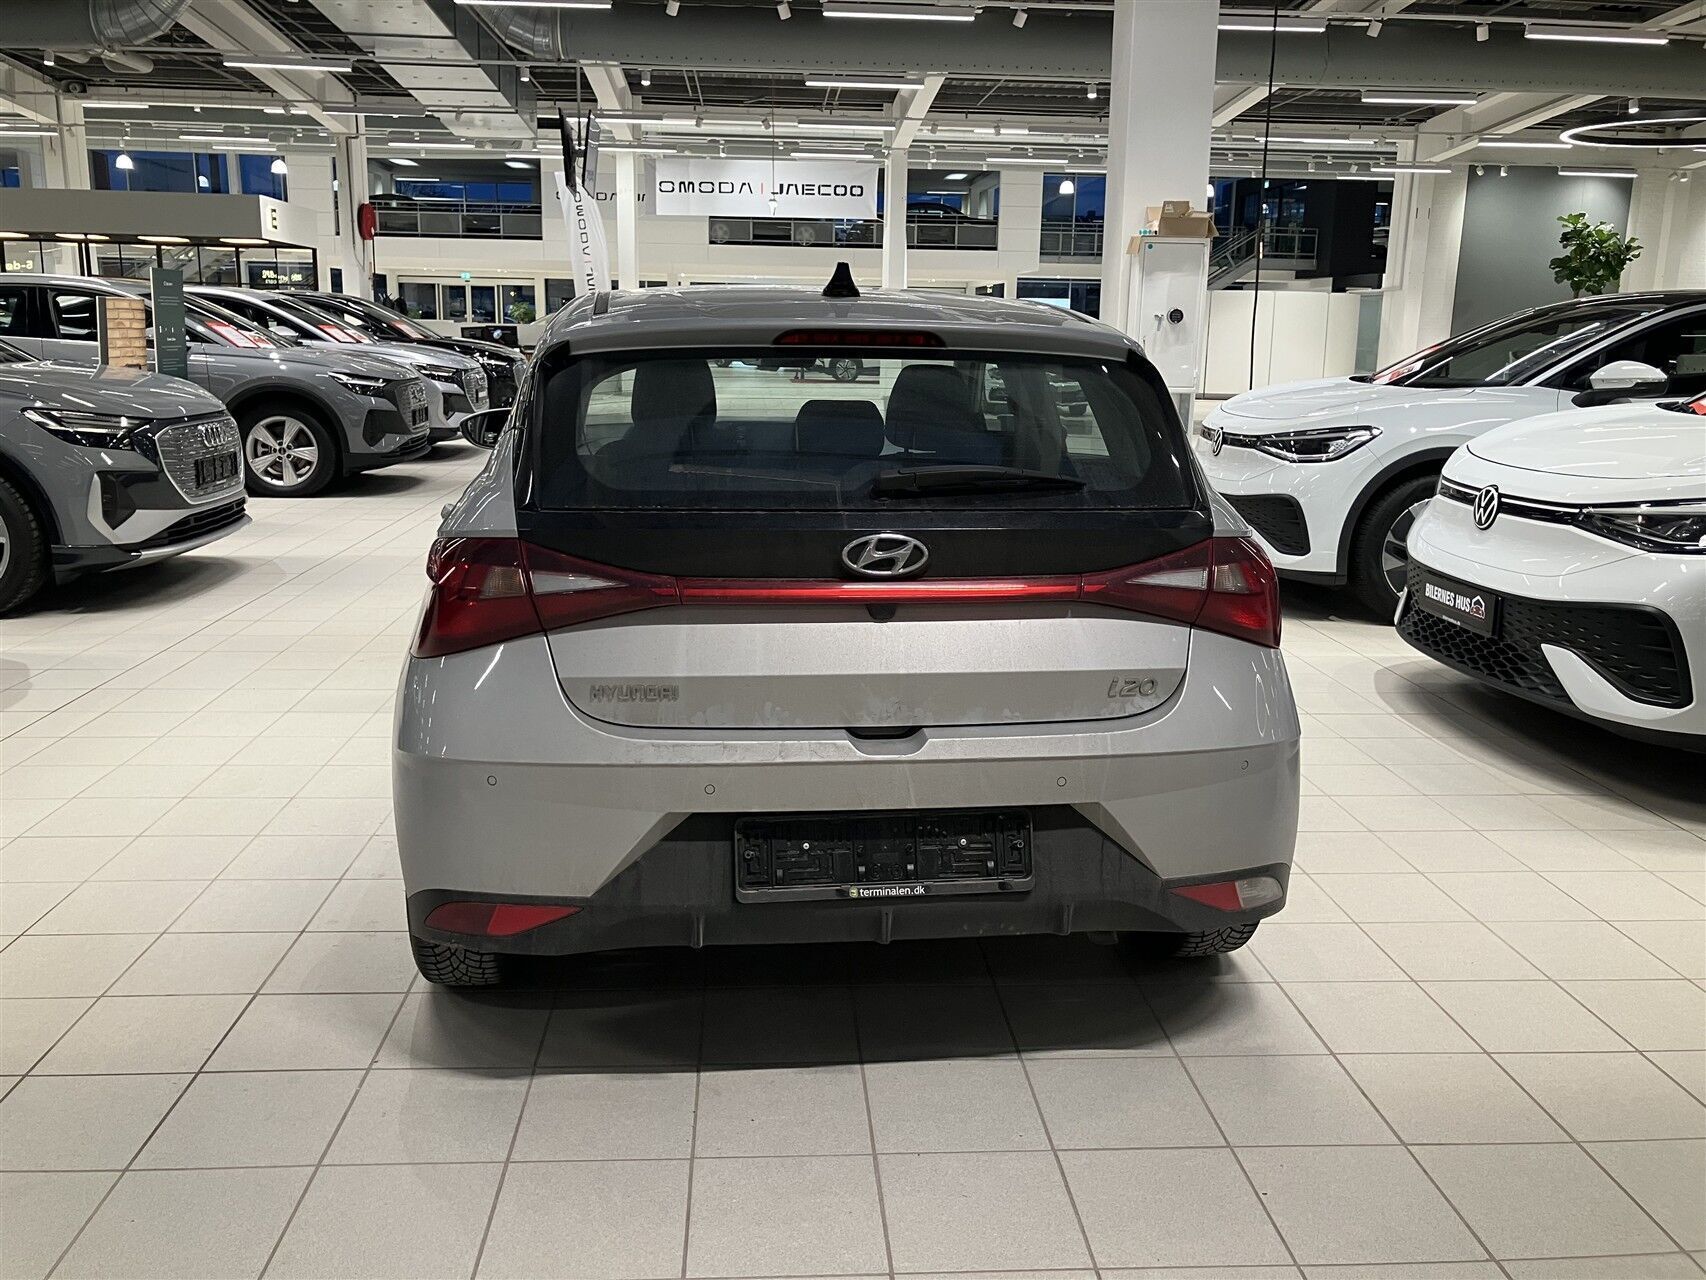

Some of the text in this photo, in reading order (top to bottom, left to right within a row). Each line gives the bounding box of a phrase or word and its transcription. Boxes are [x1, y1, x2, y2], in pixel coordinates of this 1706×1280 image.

[659, 181, 865, 198] OMODA JAECOO
[1425, 583, 1471, 612] BILERNES HUS
[589, 684, 680, 702] HYUNDAI
[859, 885, 926, 897] terminalen.dk
